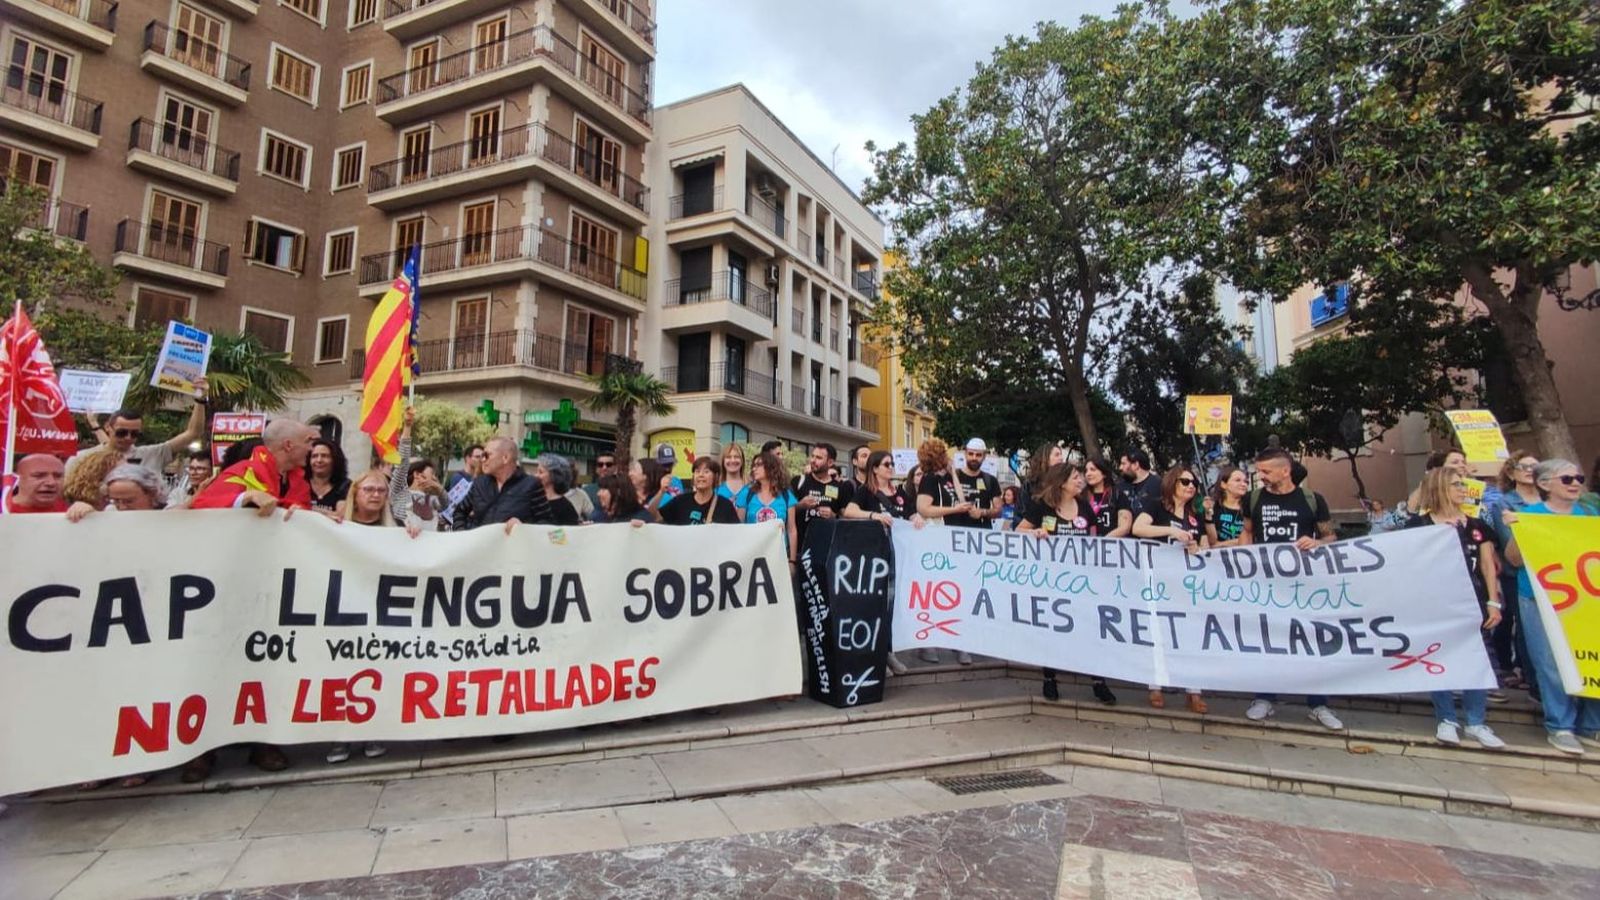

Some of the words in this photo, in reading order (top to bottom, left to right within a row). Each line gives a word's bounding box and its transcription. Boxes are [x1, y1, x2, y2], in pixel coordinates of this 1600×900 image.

[216, 417, 262, 430] STOP
[951, 530, 1161, 570] ENSENYAMENT
[834, 554, 889, 595] R.I.P.
[976, 558, 1099, 595] pública
[1113, 579, 1128, 599] i
[1141, 575, 1170, 601] de
[1183, 574, 1363, 610] qualitat
[8, 574, 216, 652] CAP
[278, 568, 592, 628] LLENGUA
[624, 557, 778, 623] SOBRA
[908, 580, 962, 611] NO
[972, 588, 996, 620] A
[1011, 592, 1075, 633] LES
[245, 630, 297, 662] eoi
[838, 617, 881, 651] EOI
[807, 627, 830, 694] ENGLISH
[113, 694, 207, 756] NO
[233, 681, 267, 725] A
[291, 669, 382, 724] LES
[401, 657, 660, 723] RETALLADES
